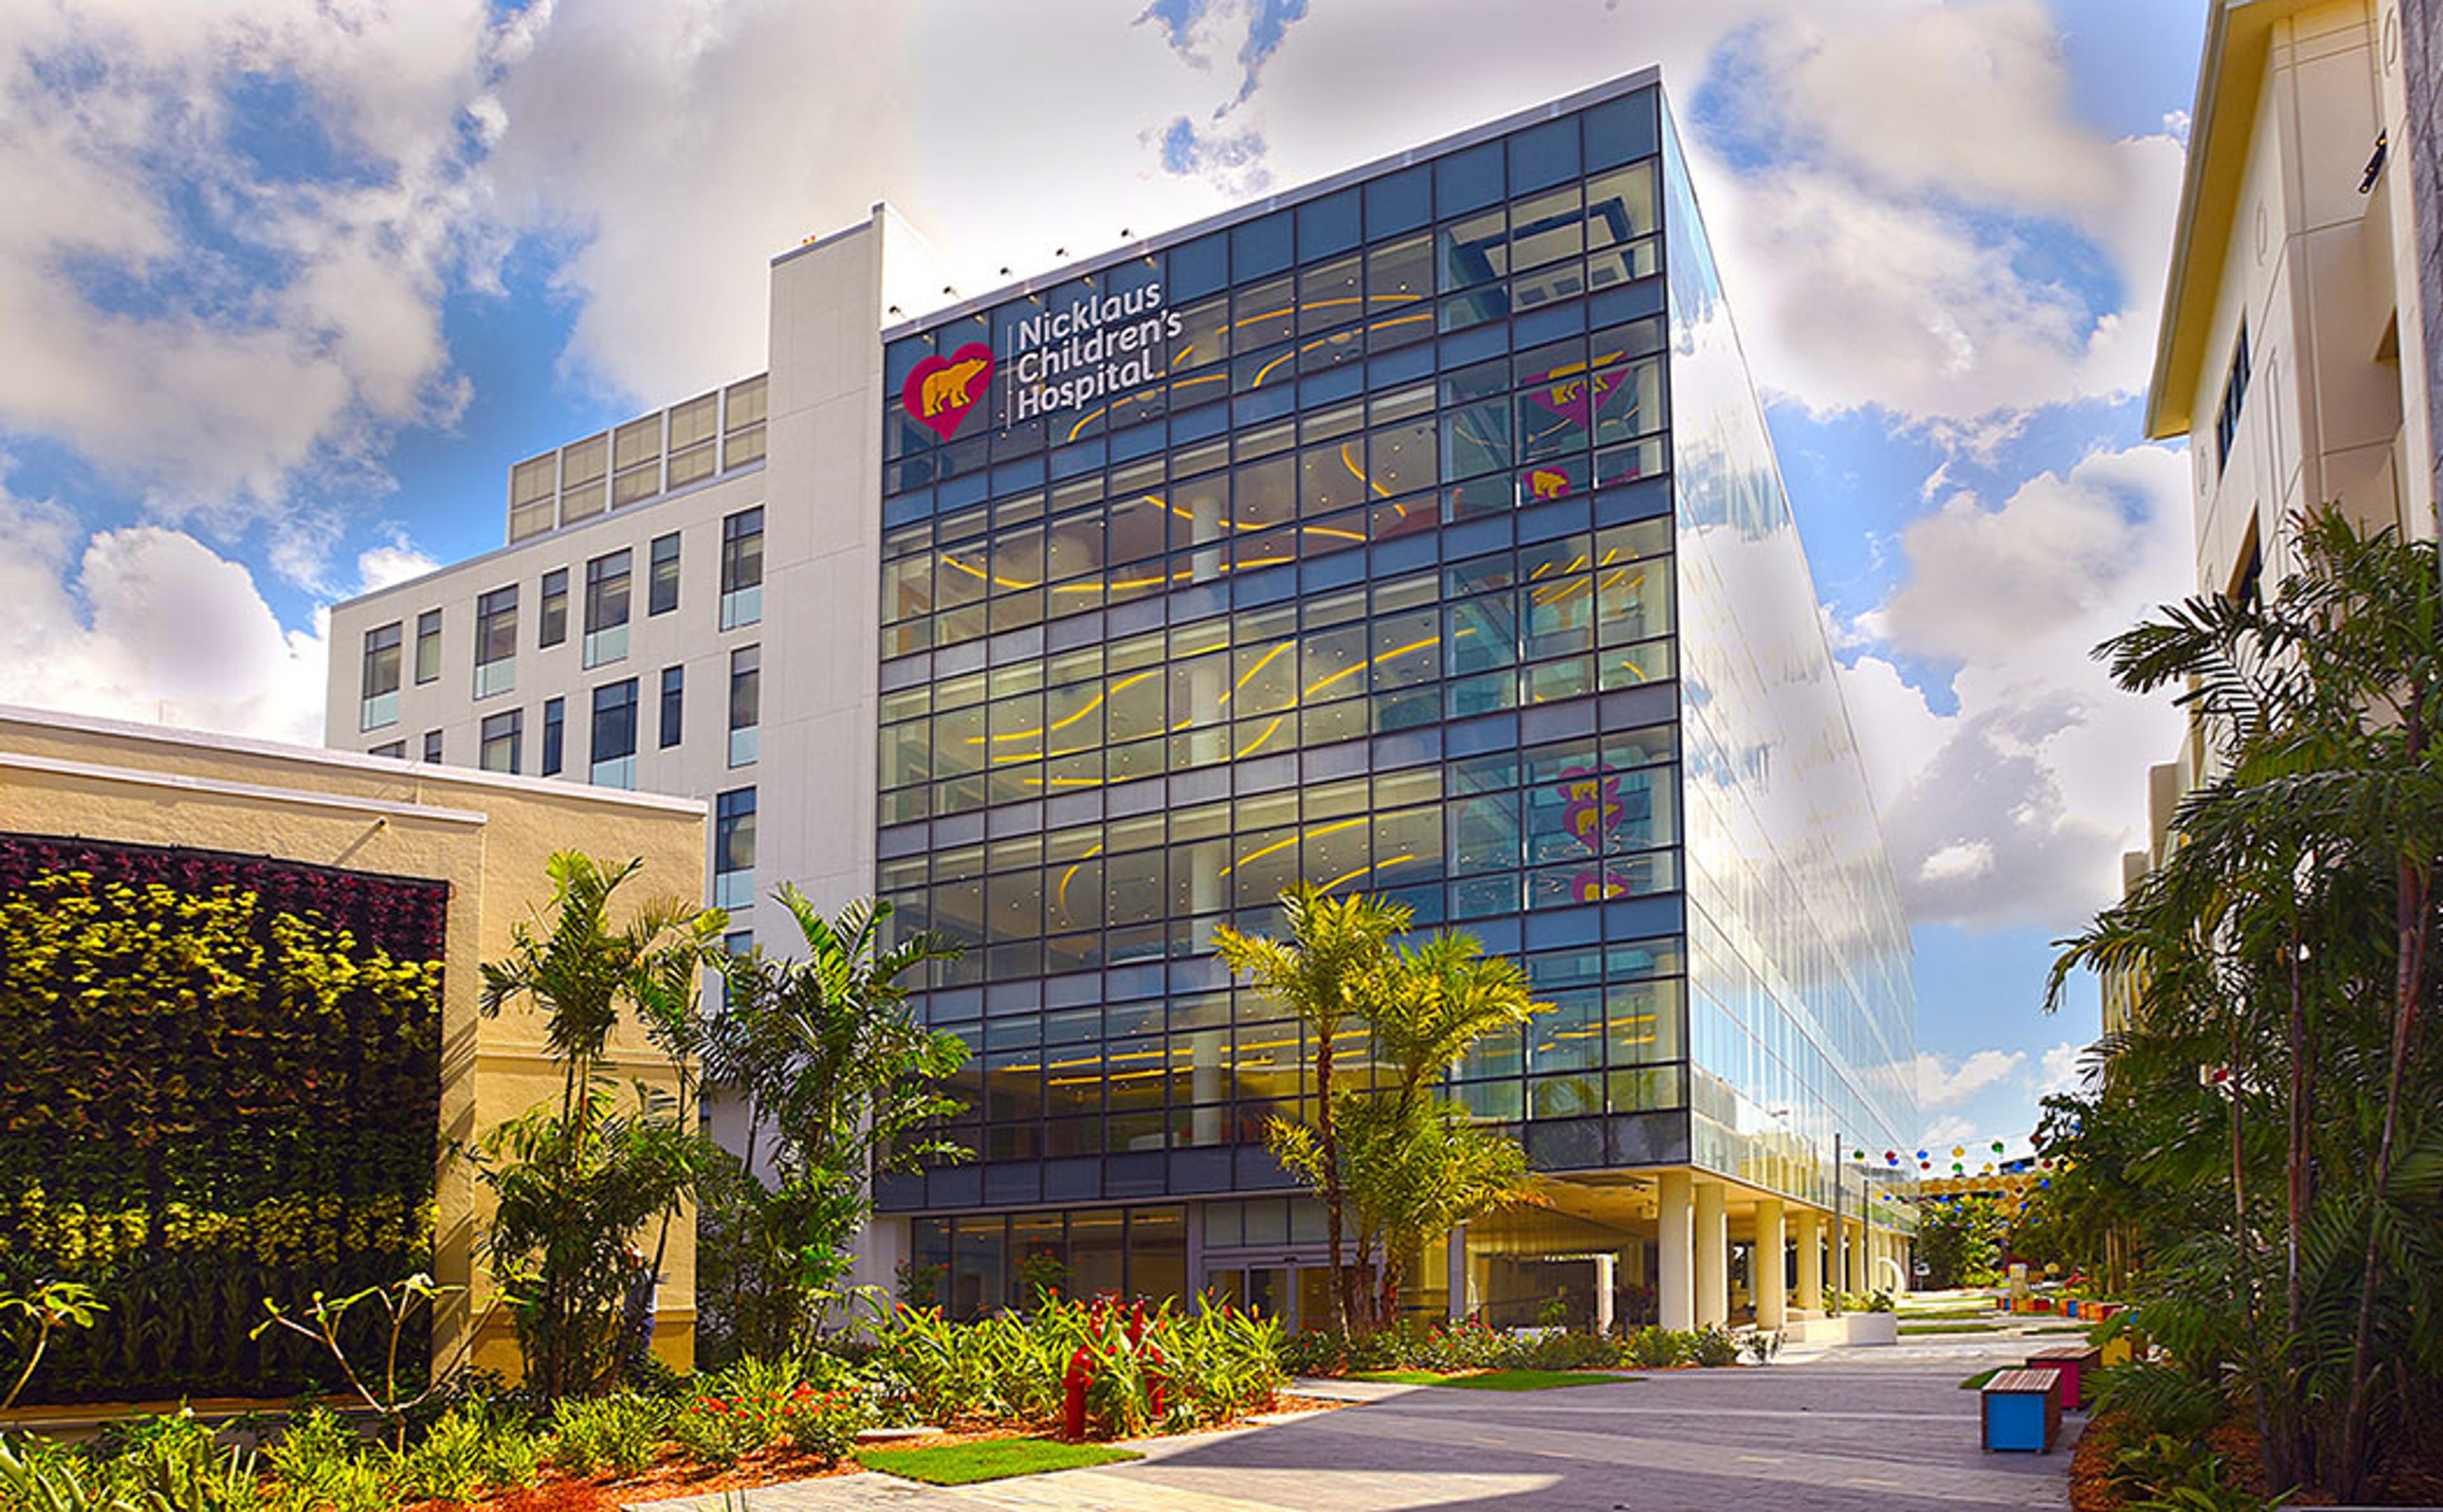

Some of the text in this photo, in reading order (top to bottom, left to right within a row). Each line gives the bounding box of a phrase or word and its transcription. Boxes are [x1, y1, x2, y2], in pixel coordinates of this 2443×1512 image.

[1019, 310, 1182, 383] Children's
[1020, 283, 1160, 350] Nicklaus
[1018, 350, 1155, 419] Hospital
